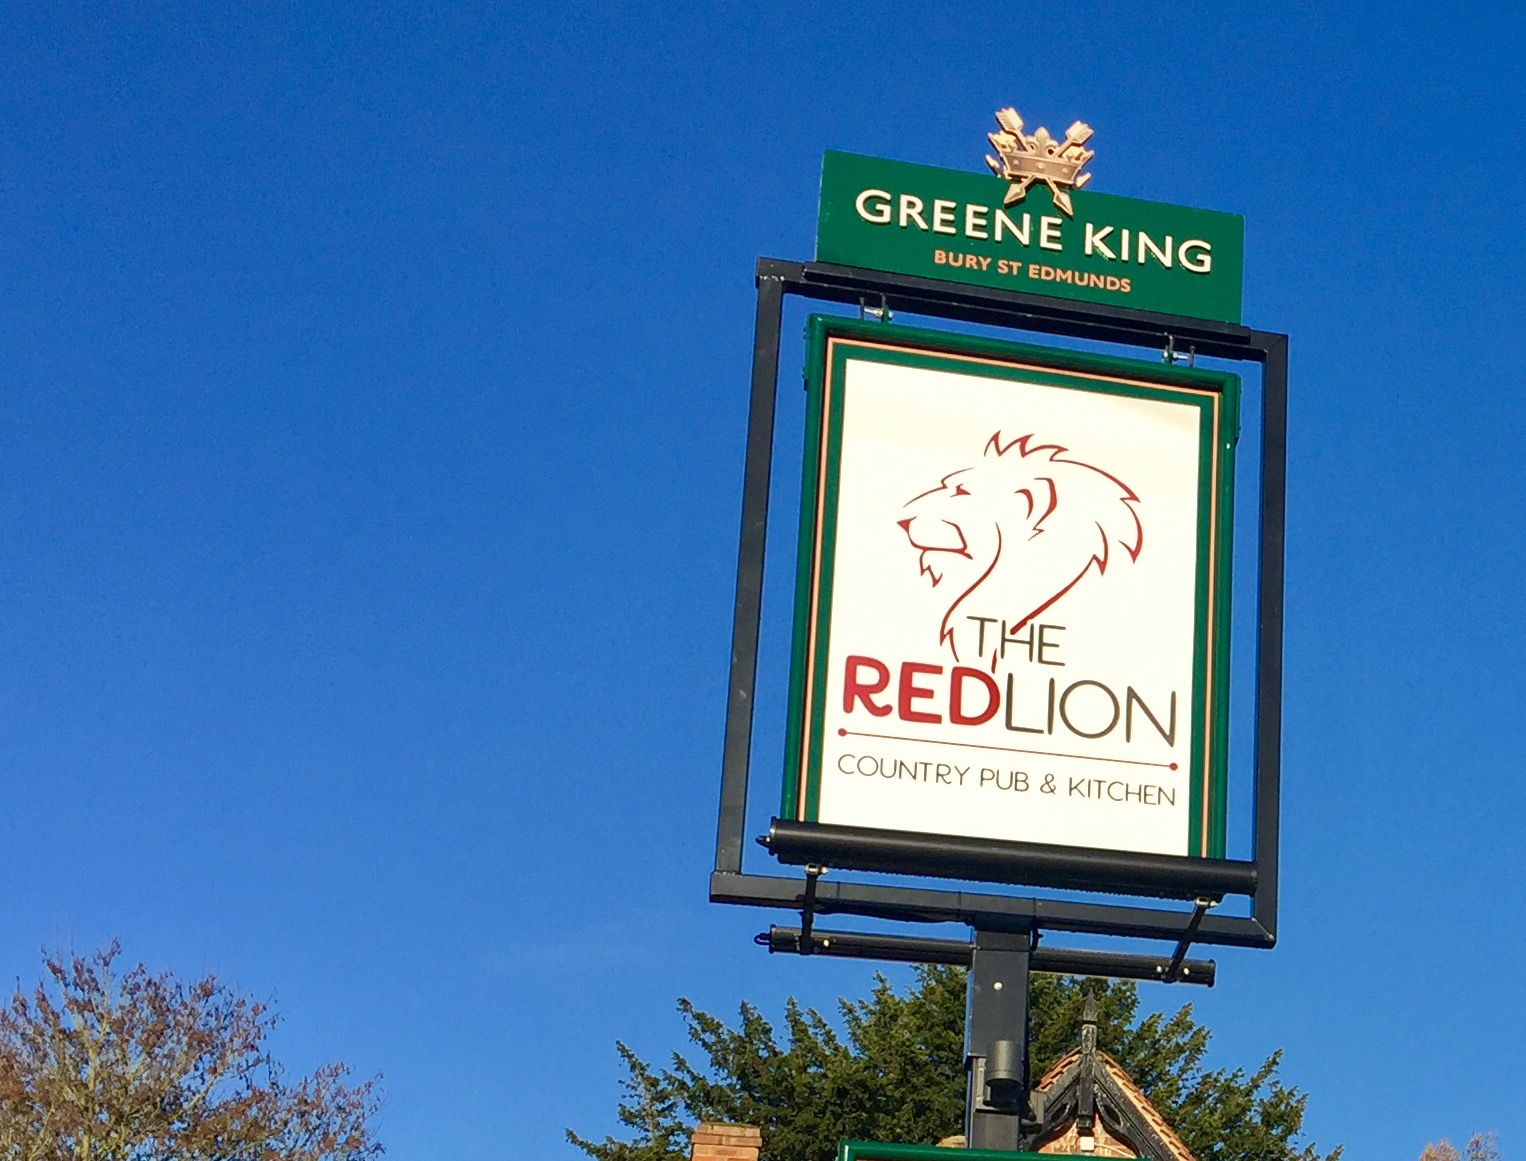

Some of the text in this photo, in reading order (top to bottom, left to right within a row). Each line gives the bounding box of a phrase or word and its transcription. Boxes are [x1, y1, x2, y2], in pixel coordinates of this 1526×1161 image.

[855, 188, 1212, 273] GREENE KING
[934, 249, 1131, 293] BURY ST EDMUNDS
[966, 615, 1066, 666] THE
[838, 754, 1176, 806] COUNTRY PUB & KITCHEN
